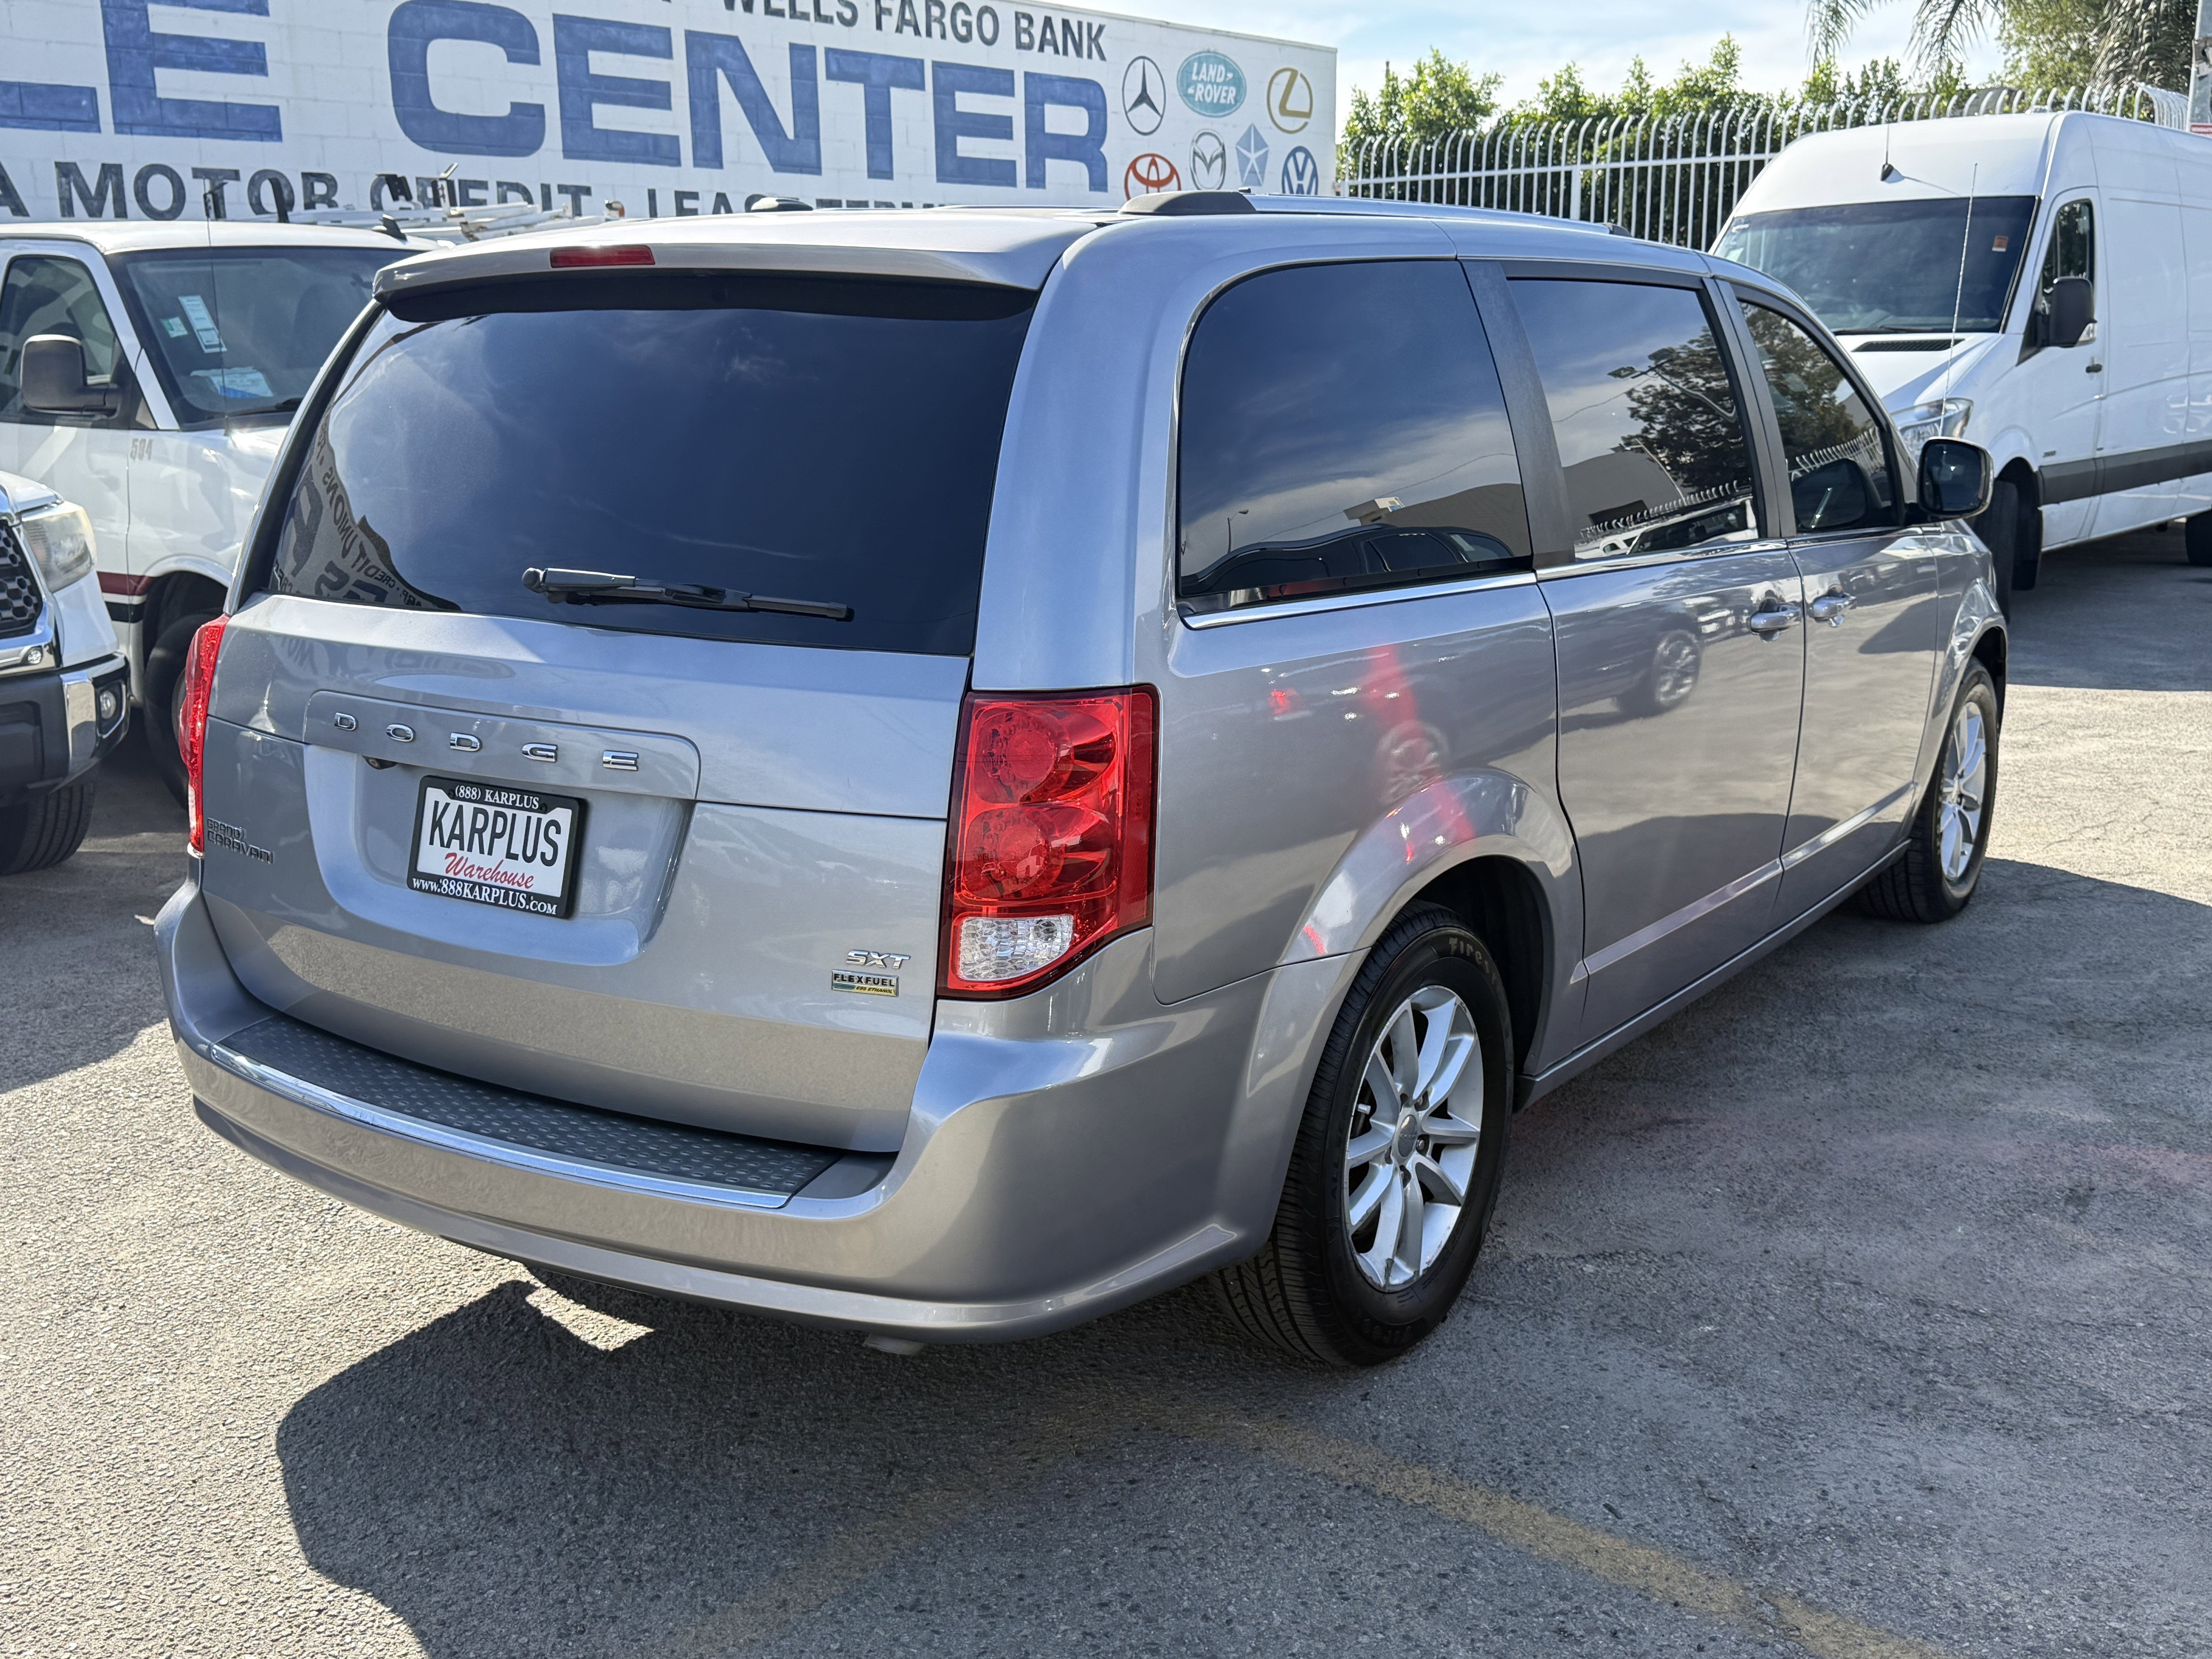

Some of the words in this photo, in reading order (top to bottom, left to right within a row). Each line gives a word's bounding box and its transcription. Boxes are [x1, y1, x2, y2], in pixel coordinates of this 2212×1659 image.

[875, 0, 999, 46] FARGO
[1015, 11, 1107, 62] BANK
[1192, 62, 1226, 83] LAND
[387, 0, 1108, 192] CENTER
[1195, 83, 1236, 105] ROVER
[54, 161, 338, 221] MOTOR
[334, 712, 639, 771] DODGE
[455, 785, 481, 801] (888)
[484, 789, 539, 810] KARPLUS
[207, 818, 244, 840] GRAND
[429, 800, 561, 867] KARPLUS
[208, 830, 274, 864] CARAVAN
[445, 852, 534, 889] Warehouse
[846, 950, 911, 969] SXT
[834, 973, 894, 987] FLEXFUEL
